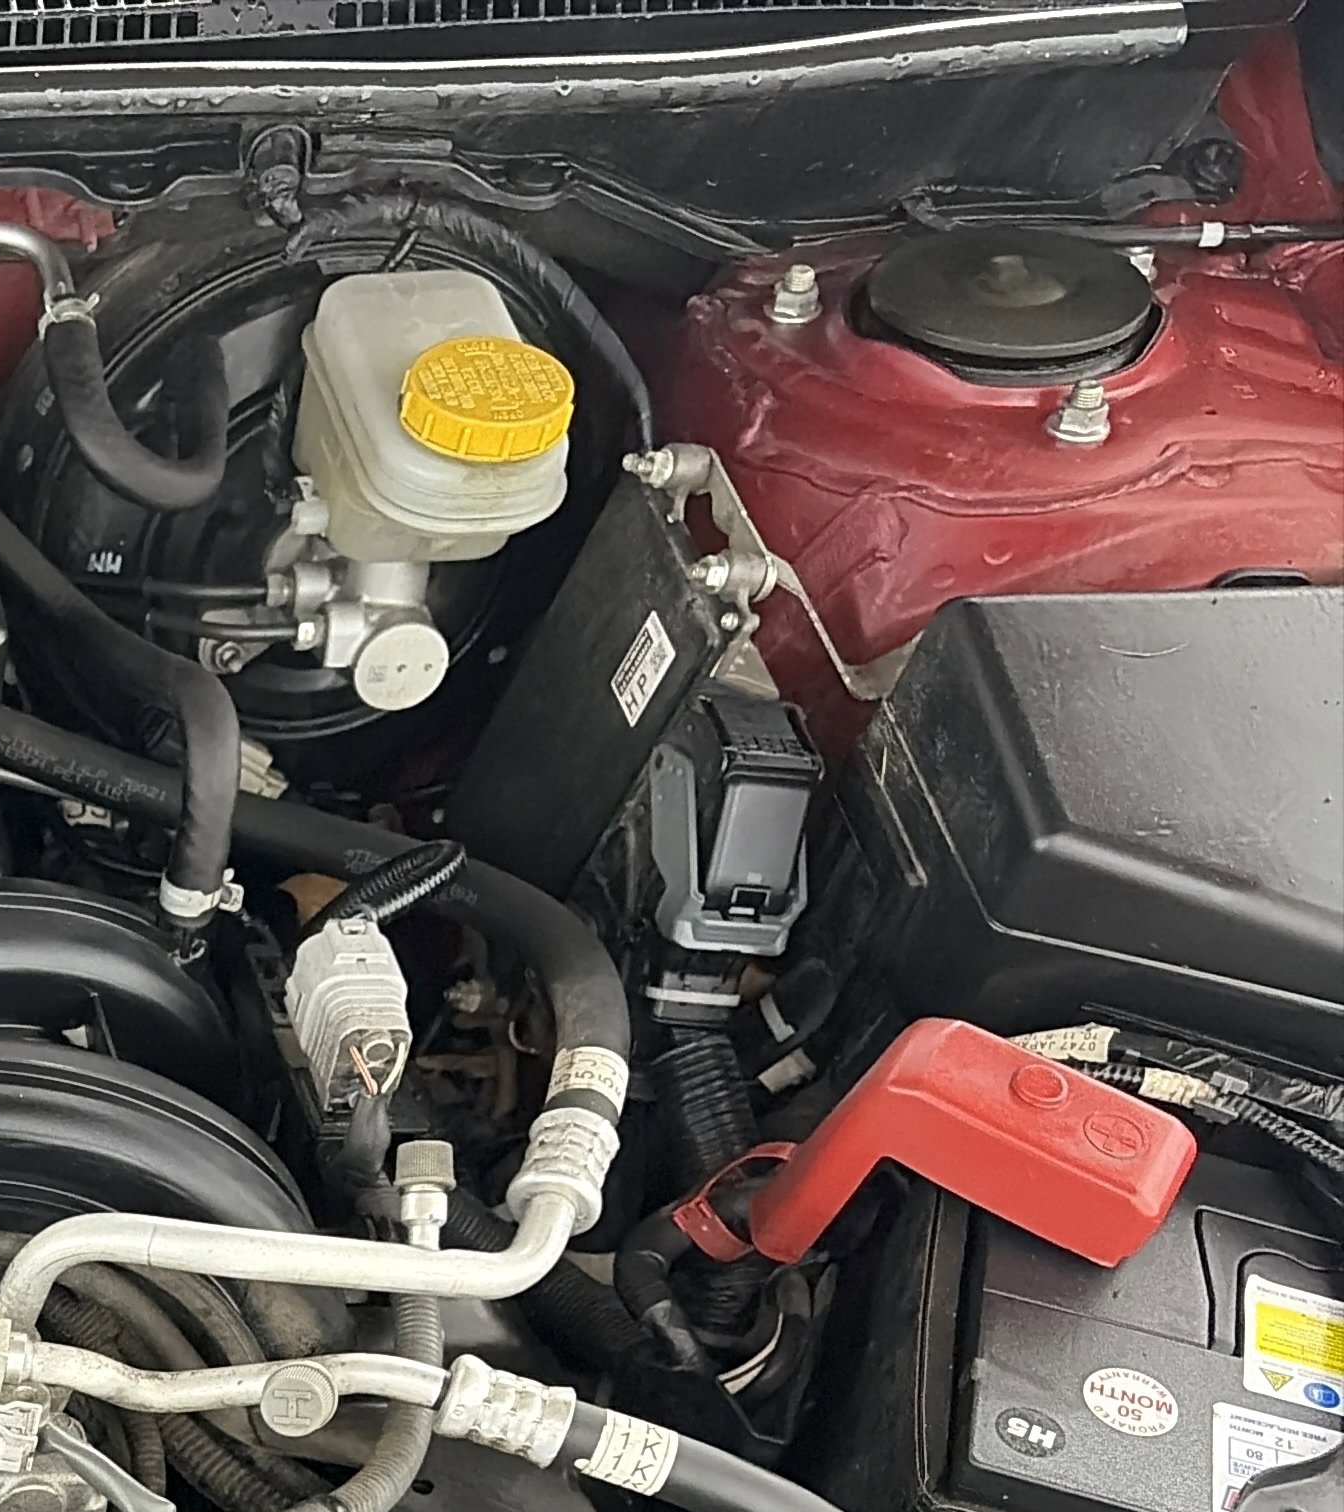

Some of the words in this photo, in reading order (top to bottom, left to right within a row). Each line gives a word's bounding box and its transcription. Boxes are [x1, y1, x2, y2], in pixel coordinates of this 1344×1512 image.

[1098, 1369, 1168, 1399] WARRANTY
[1089, 1381, 1173, 1416] MONTH
[1093, 1405, 1166, 1434] PRORATED
[1117, 1404, 1143, 1422] 50
[1230, 1413, 1300, 1437] REPLACEMENT
[1007, 1416, 1057, 1449] H5
[1229, 1423, 1264, 1438] MONTH
[1246, 1448, 1264, 1461] 80
